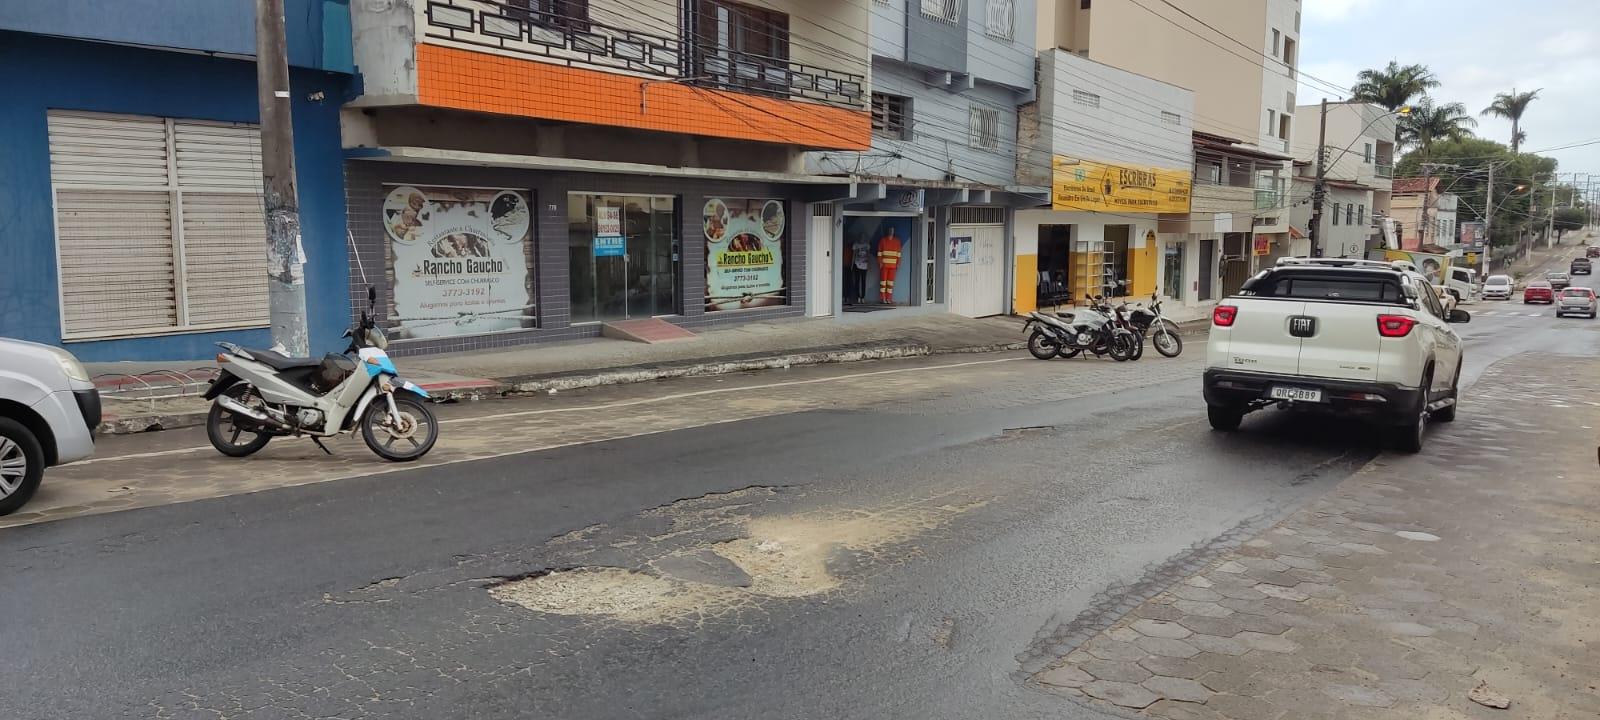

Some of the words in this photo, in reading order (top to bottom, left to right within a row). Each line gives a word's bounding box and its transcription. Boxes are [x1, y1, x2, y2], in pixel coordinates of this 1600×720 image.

[1119, 169, 1156, 187] ESCRIBRAS
[723, 253, 745, 265] Rancho
[747, 252, 769, 264] Gaucho
[423, 259, 463, 275] Rancho
[466, 258, 503, 274] Gaucho
[442, 287, 485, 297] 3773-3192
[1294, 318, 1311, 332] FIAT
